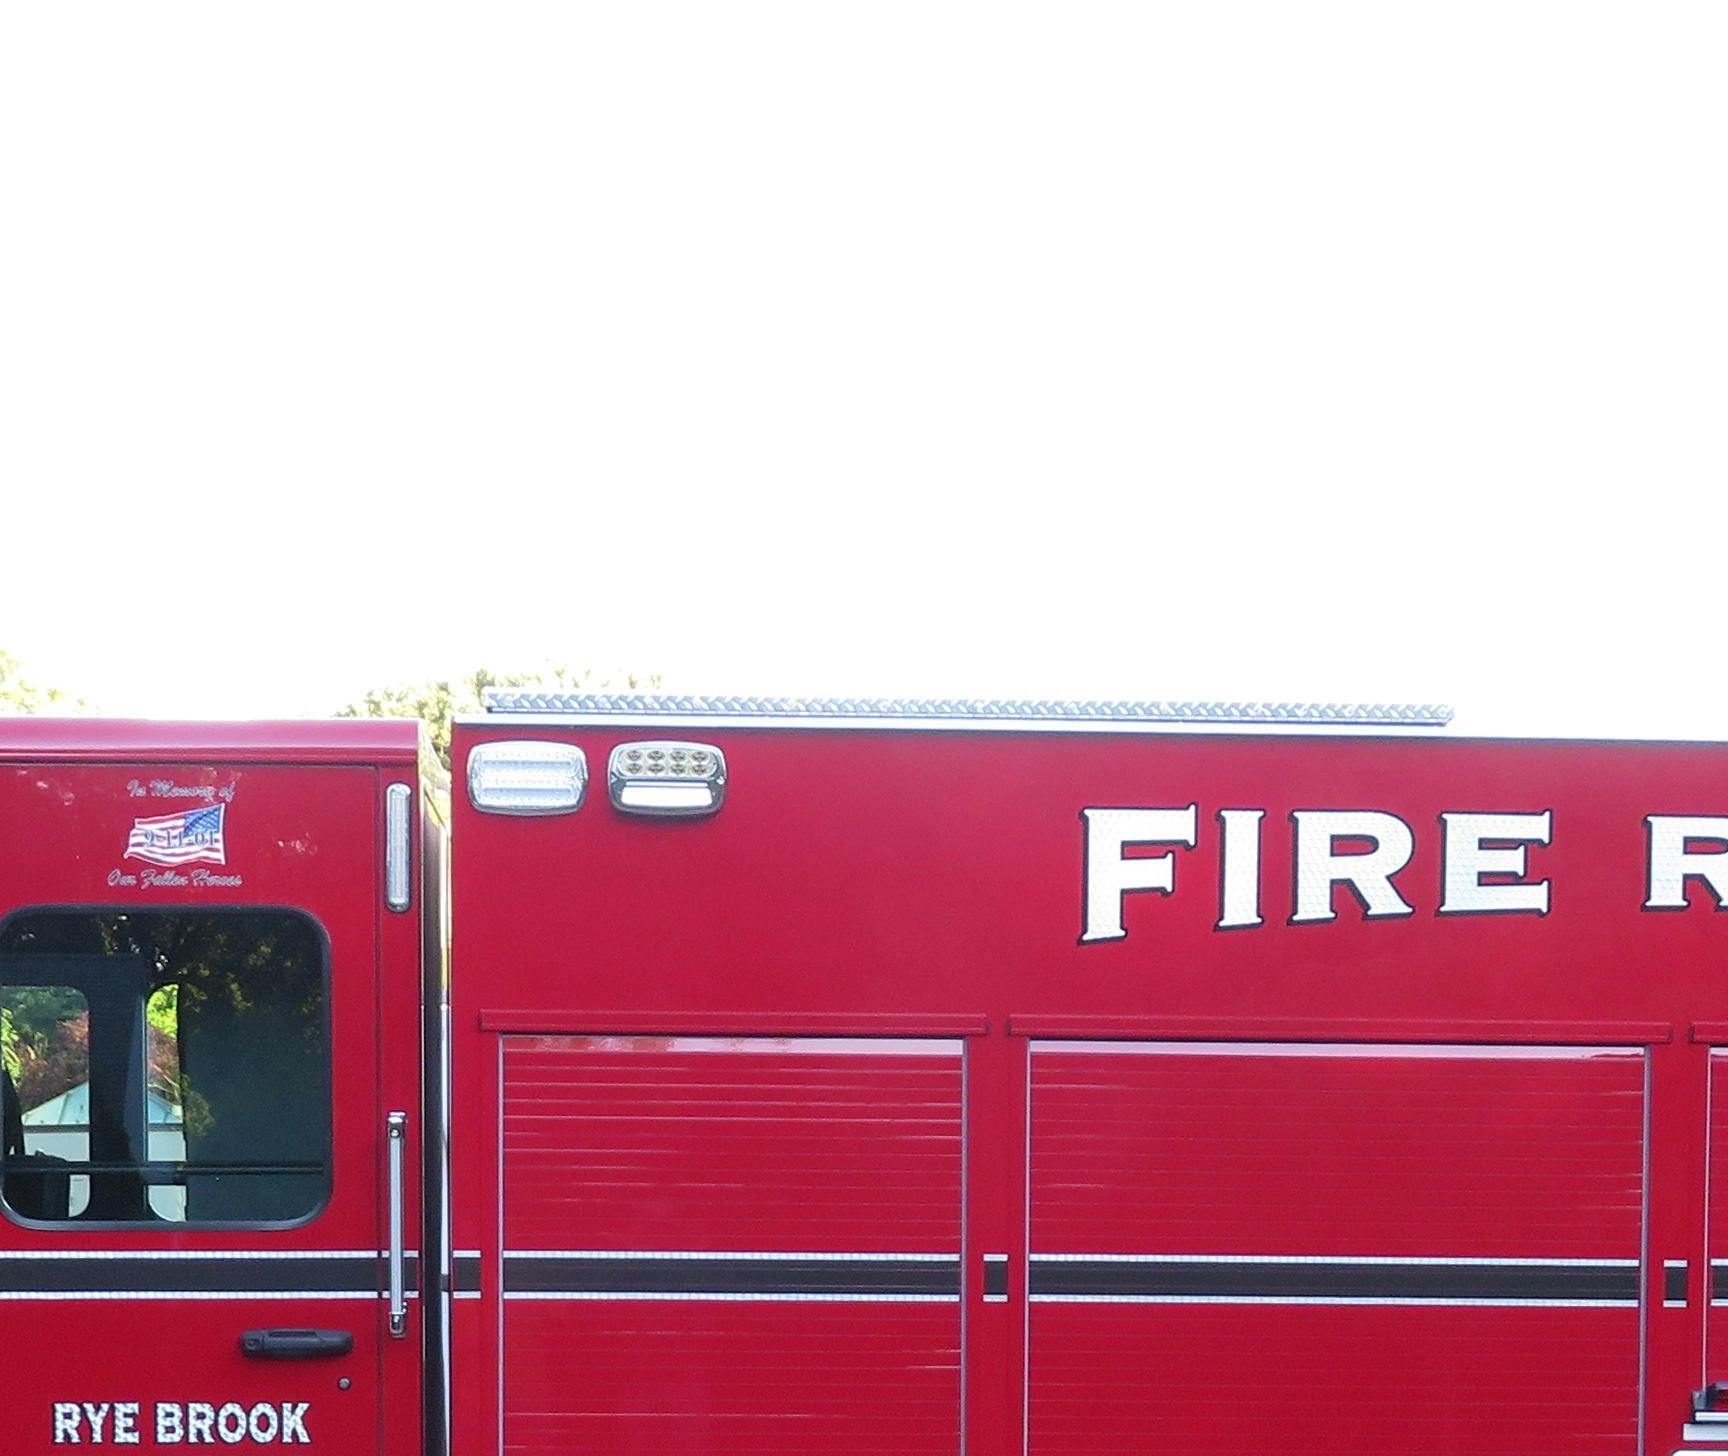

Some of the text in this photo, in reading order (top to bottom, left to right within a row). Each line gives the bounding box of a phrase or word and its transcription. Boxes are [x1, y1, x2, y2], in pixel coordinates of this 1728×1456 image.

[126, 779, 236, 802] In Memory of
[106, 868, 243, 890] Our Fallen Heroes
[1077, 802, 1553, 945] FIRE
[52, 1401, 312, 1444] RYE BROOK
